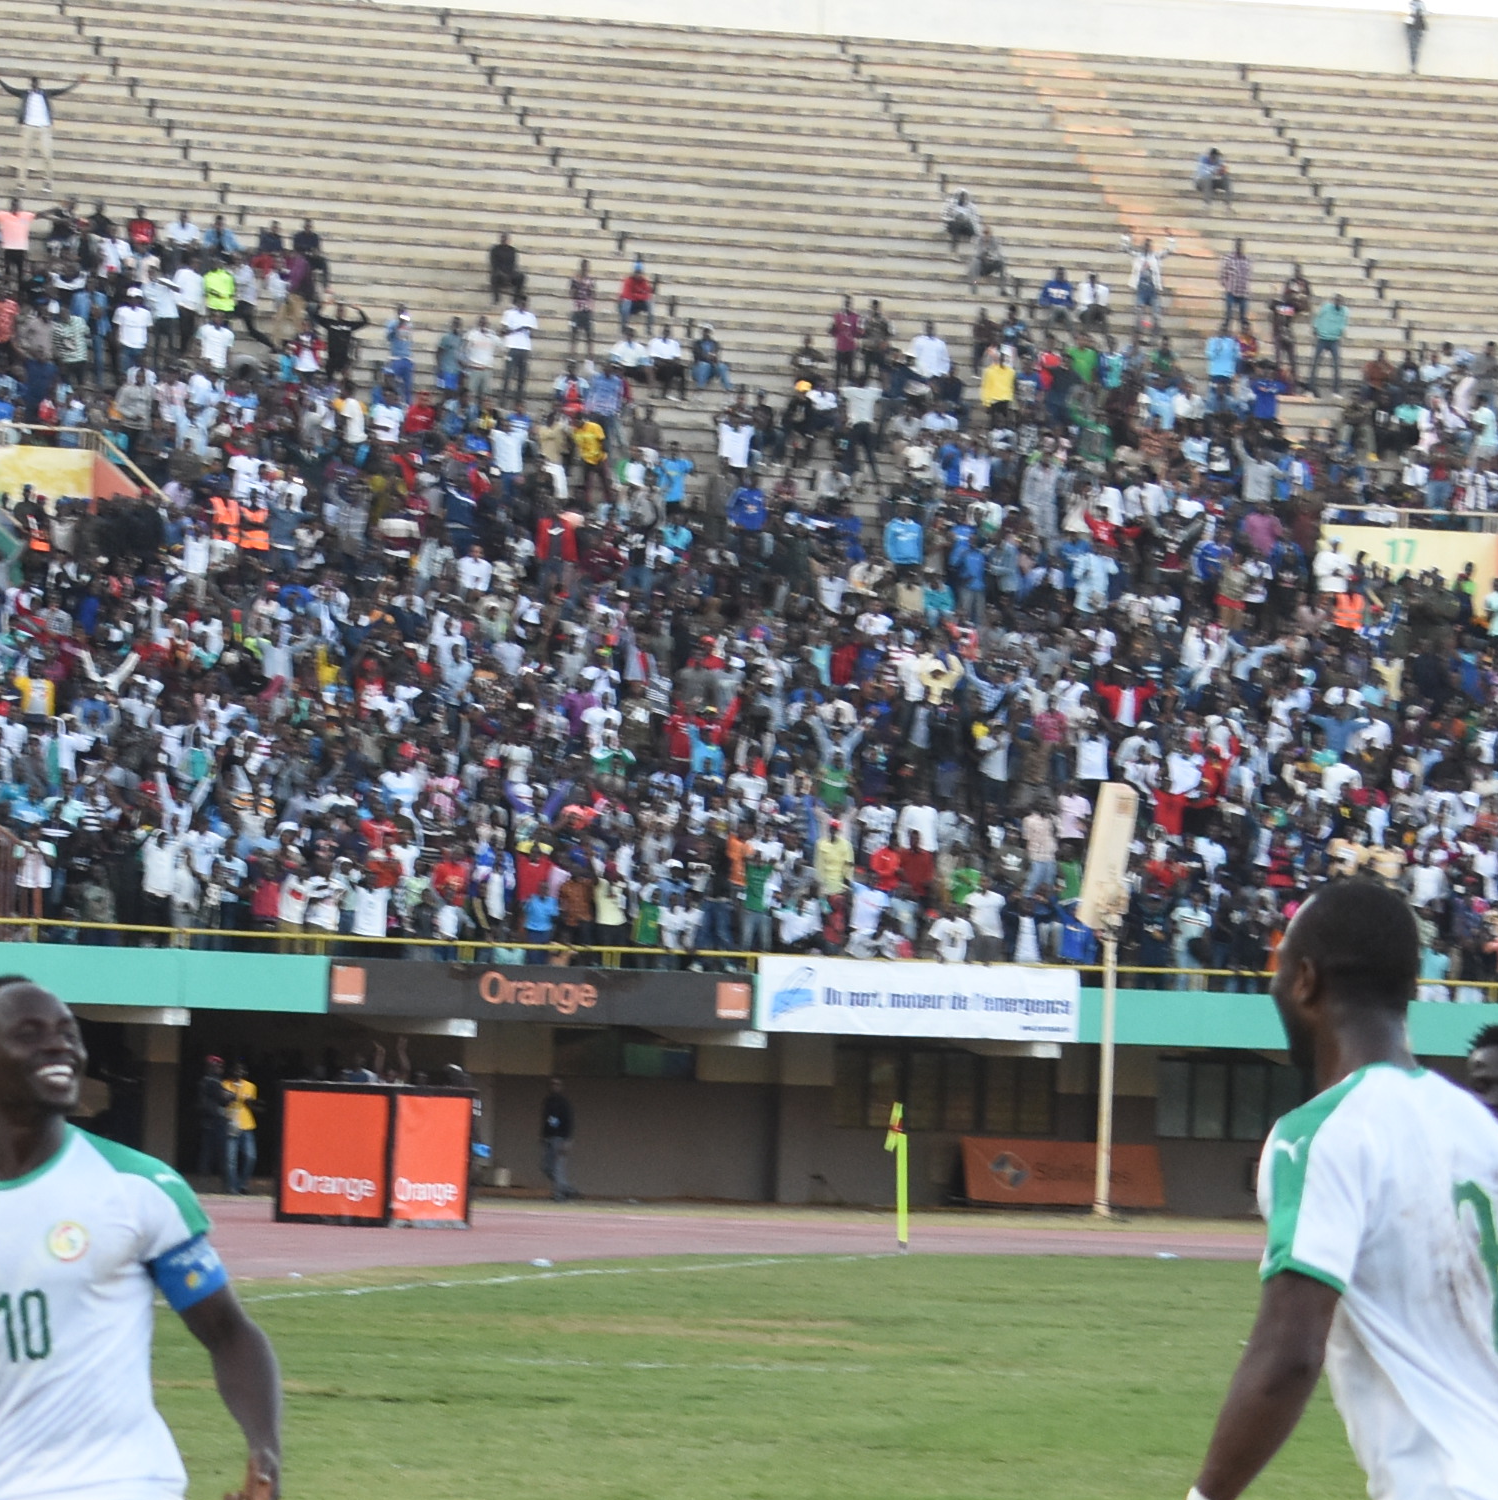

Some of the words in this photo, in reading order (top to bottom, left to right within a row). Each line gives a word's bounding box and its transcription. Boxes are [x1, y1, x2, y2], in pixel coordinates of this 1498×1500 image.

[1385, 538, 1418, 564] 17
[479, 970, 598, 1015] Orange
[288, 1168, 377, 1202] Orange
[394, 1177, 458, 1207] Orange
